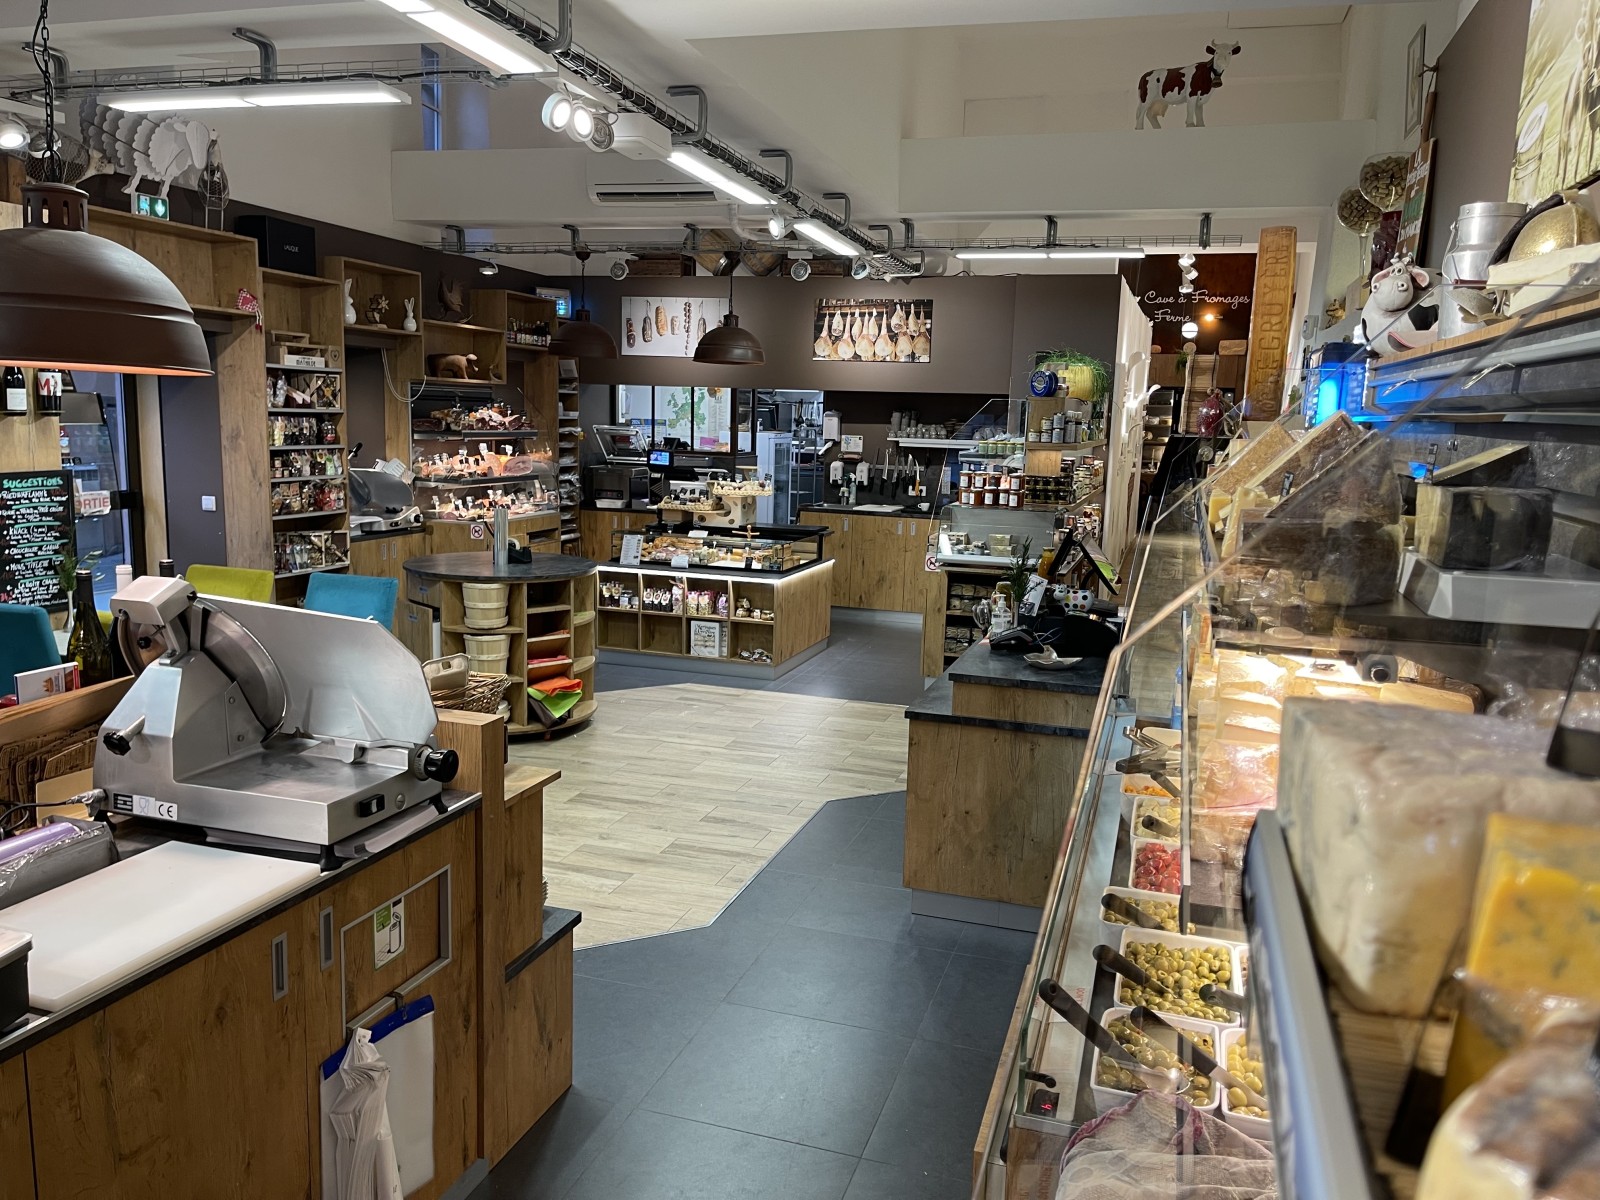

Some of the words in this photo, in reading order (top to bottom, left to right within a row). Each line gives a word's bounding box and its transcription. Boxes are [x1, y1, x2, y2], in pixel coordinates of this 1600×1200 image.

[1144, 290, 1175, 304] Cave
[1191, 289, 1251, 309] Fromages
[1259, 246, 1289, 350] GRUYÈRE
[1154, 309, 1191, 322] Ferme
